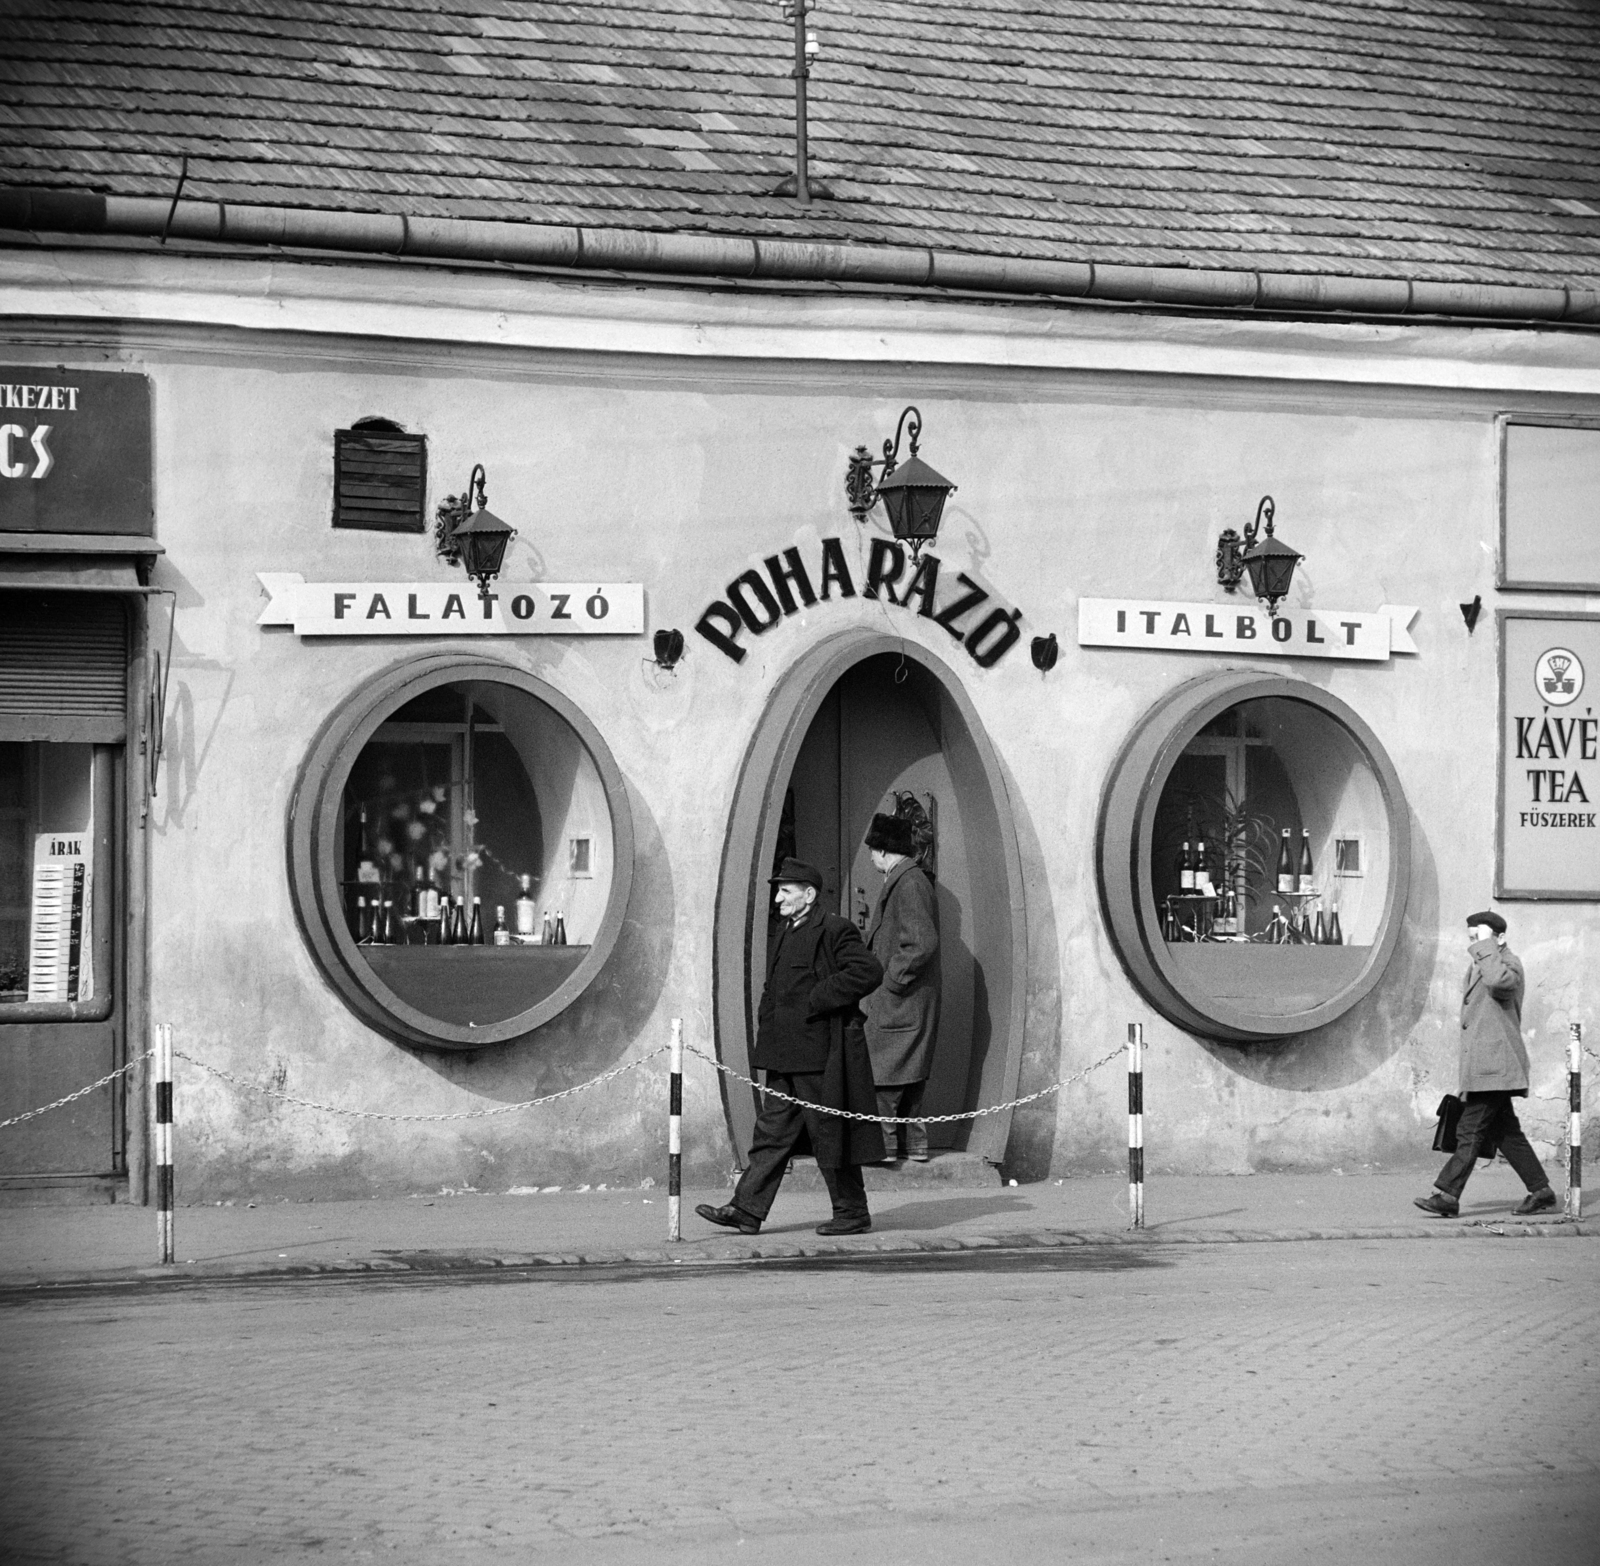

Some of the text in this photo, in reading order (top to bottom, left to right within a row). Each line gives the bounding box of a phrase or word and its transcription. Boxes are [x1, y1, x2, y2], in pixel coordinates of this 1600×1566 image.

[334, 587, 609, 620] FALATOZÓ
[695, 538, 1022, 668] POHARAZÓ
[1117, 610, 1362, 645] ITALBOLT
[1514, 705, 1598, 759] KÁVÉ
[1526, 769, 1590, 802] TEA
[49, 838, 81, 856] ÁRAK
